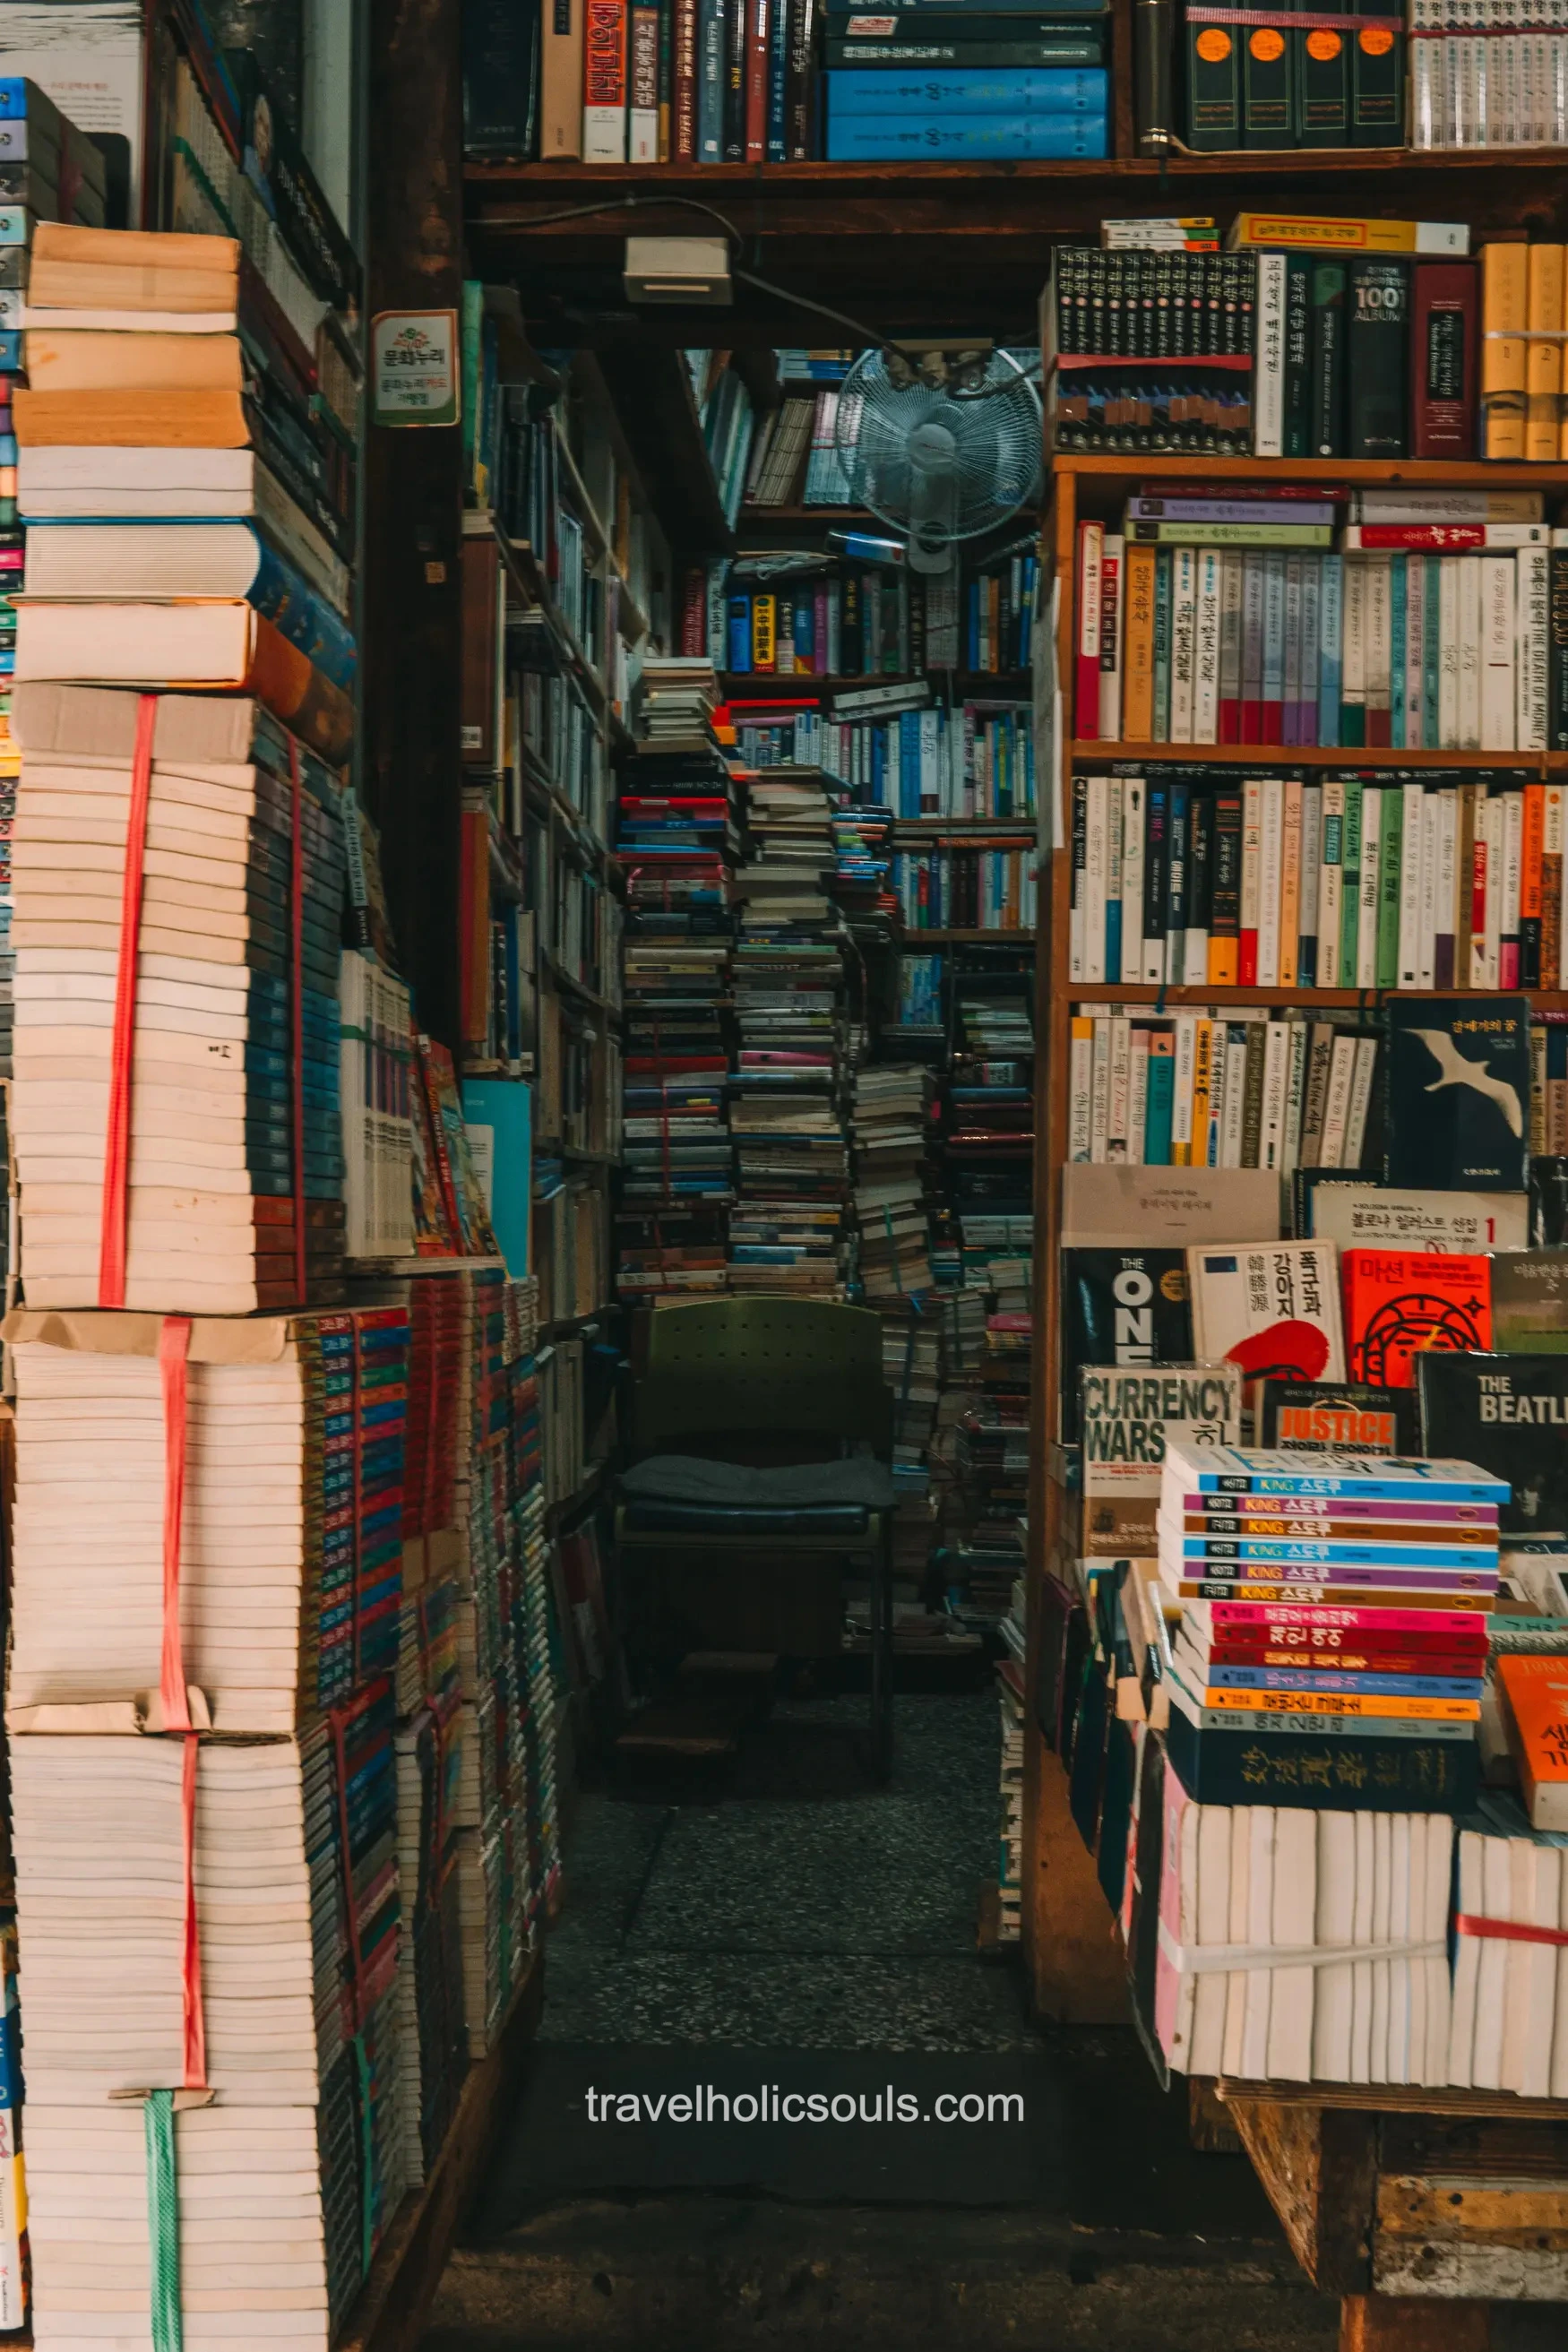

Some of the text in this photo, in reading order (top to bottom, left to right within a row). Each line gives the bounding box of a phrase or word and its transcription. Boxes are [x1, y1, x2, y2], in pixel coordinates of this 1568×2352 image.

[383, 348, 445, 366] 문화누리
[1541, 347, 1551, 361] 2
[1532, 628, 1546, 646] THE
[1532, 650, 1546, 683] DEATH
[1532, 686, 1546, 699] OF
[1531, 703, 1546, 741] MONEY
[1485, 1218, 1495, 1244] 1
[1120, 1257, 1144, 1270] THE
[1359, 1258, 1405, 1285] 마션
[1272, 1252, 1296, 1319] 강아지
[1478, 1374, 1512, 1394] THE
[1086, 1376, 1236, 1421] CURRENCY
[1279, 1408, 1393, 1445] JUSTICE
[1085, 1420, 1167, 1463] WARS
[1260, 1478, 1342, 1495] KING 스도쿠
[1245, 1497, 1330, 1515] KING 스도쿠
[1247, 1519, 1333, 1537] KING 스도쿠
[1247, 1543, 1331, 1560] KING 스도쿠
[1246, 1565, 1331, 1582] KING 스도쿠
[1240, 1585, 1325, 1603] KING 스도쿠
[1270, 1625, 1345, 1647] 제인 에어
